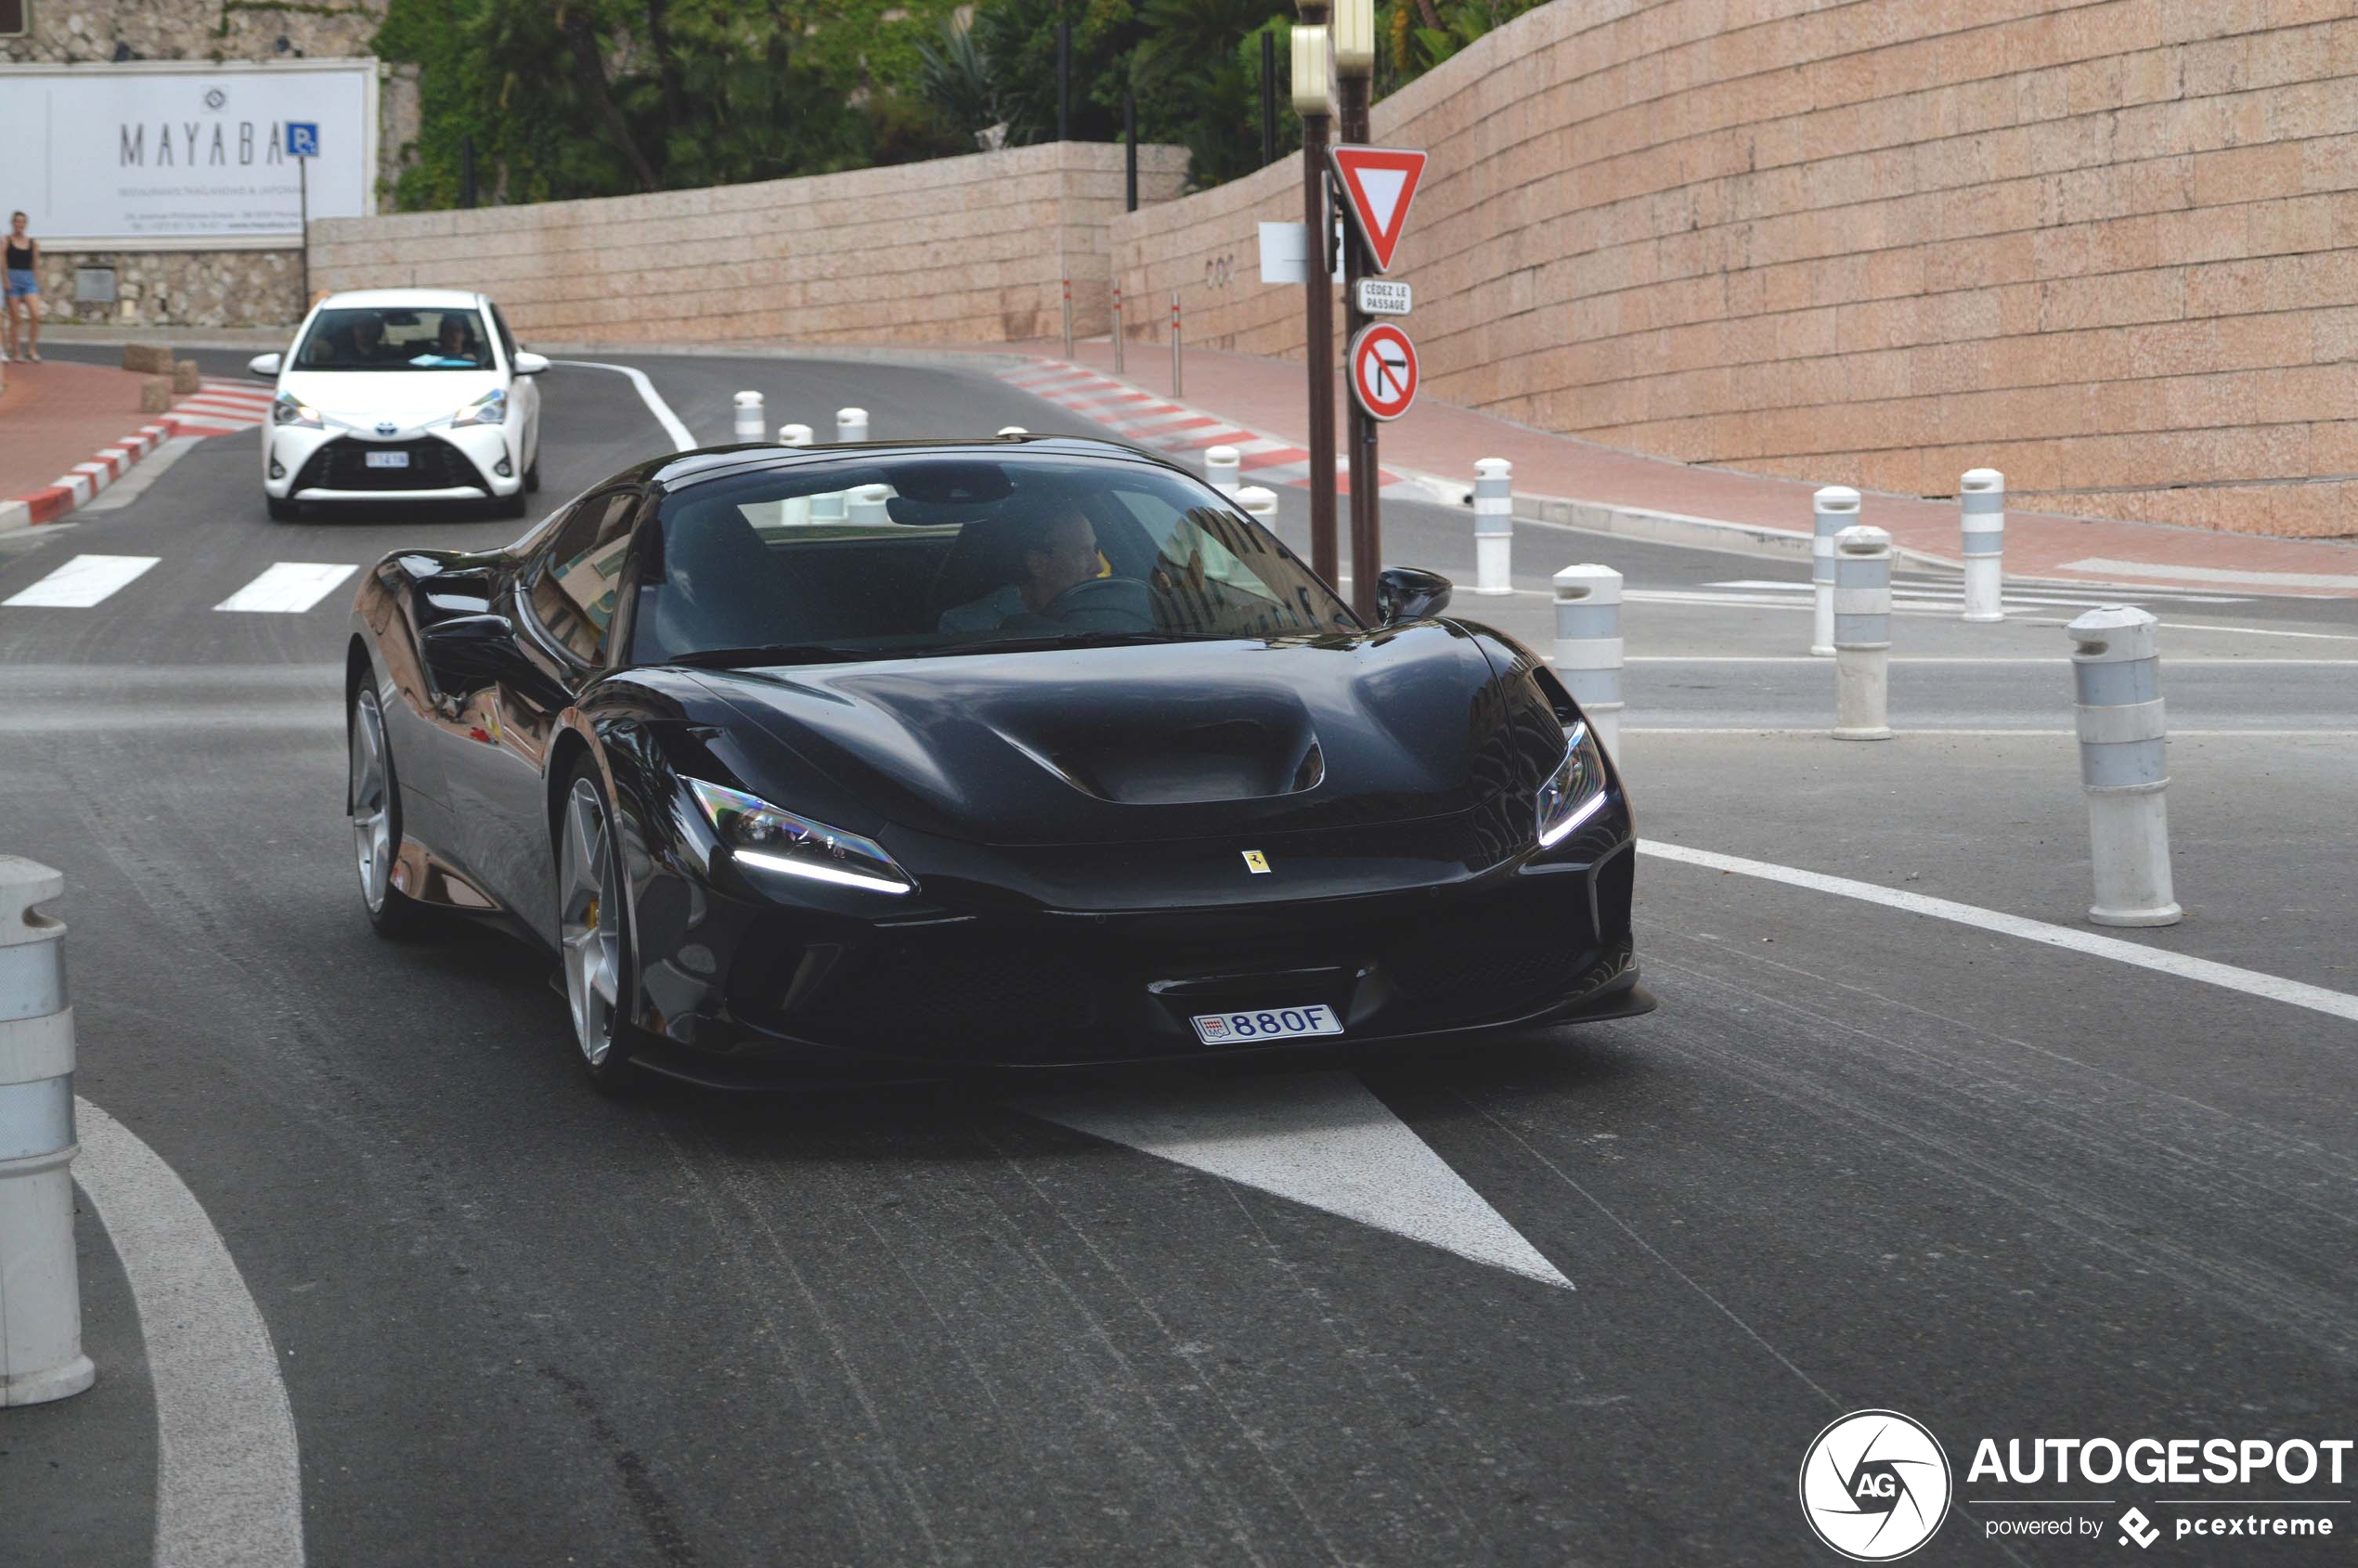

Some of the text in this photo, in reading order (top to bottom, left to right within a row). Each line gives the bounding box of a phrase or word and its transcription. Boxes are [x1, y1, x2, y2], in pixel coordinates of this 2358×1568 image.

[120, 122, 283, 166] MAYABA
[293, 126, 310, 149] P
[1396, 286, 1407, 297] LE
[1367, 298, 1406, 310] PASSAGE
[1231, 1007, 1324, 1036] 880F
